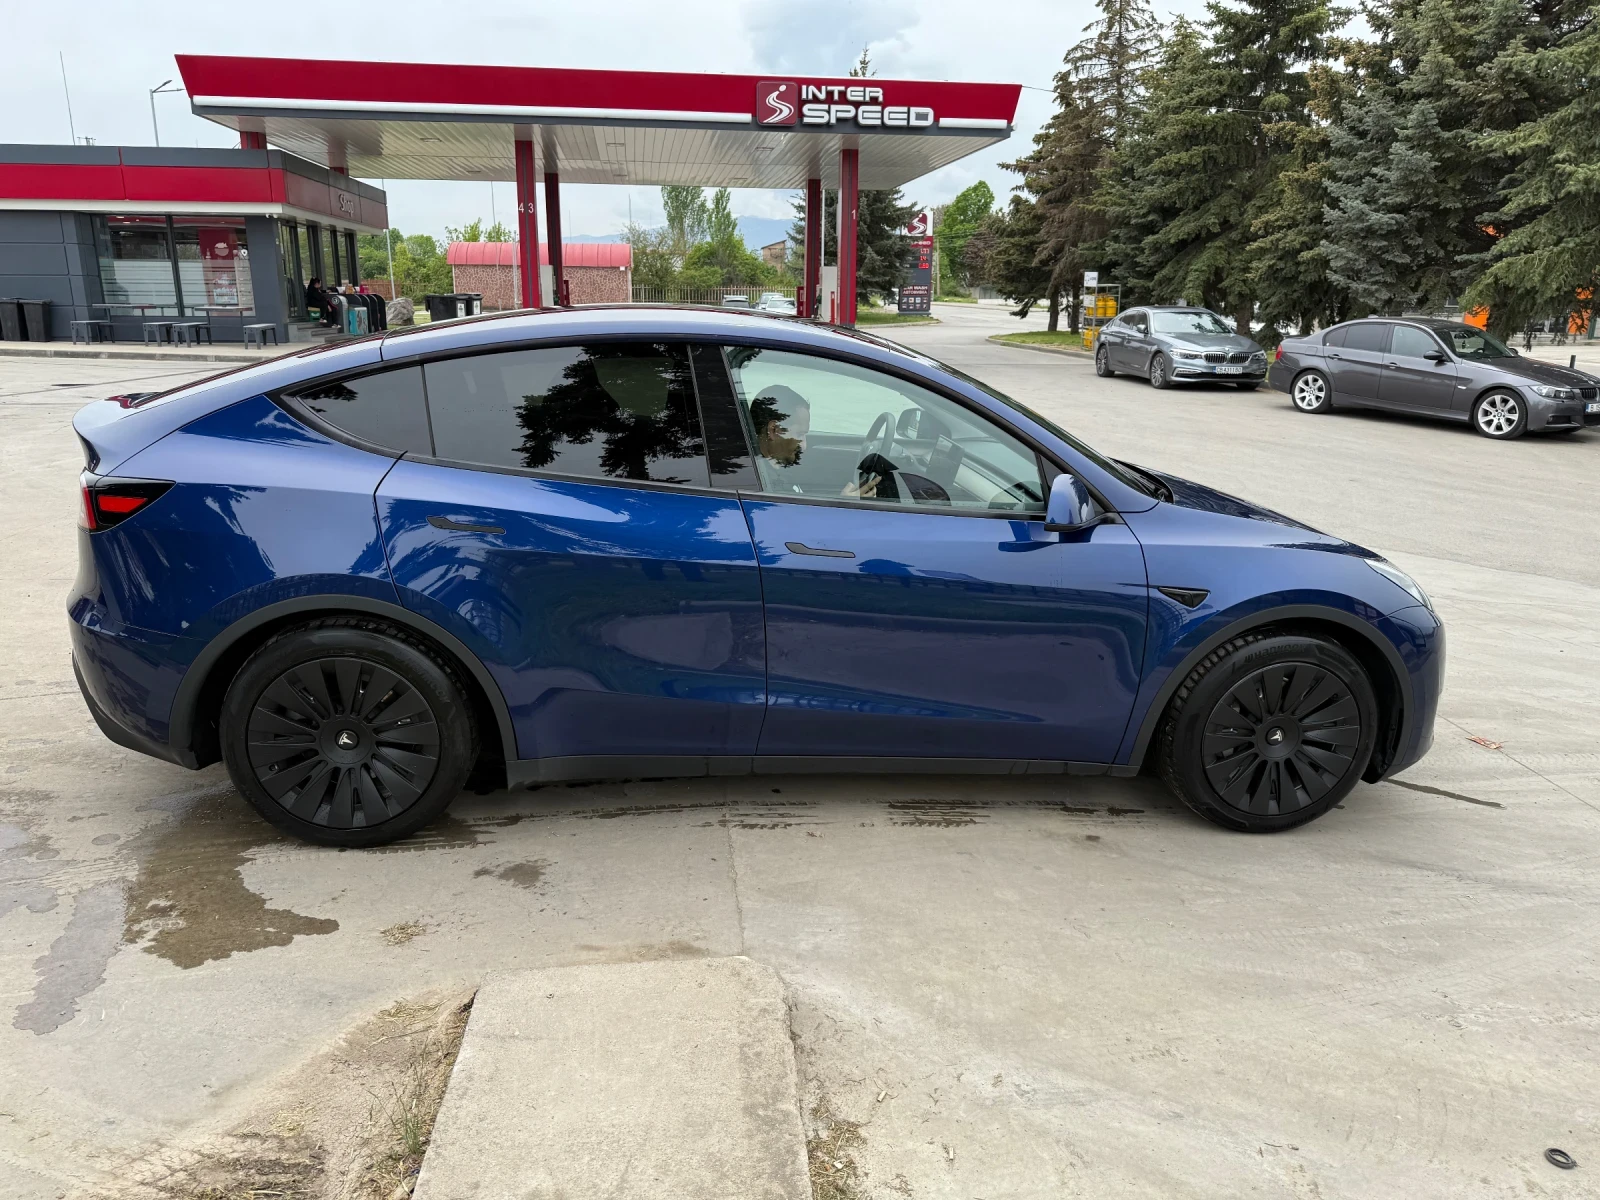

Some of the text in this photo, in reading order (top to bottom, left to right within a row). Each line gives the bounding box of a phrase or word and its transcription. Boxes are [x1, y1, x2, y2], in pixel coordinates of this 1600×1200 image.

[802, 85, 883, 102] INTER
[802, 104, 934, 126] SPEED
[339, 193, 354, 217] Shop
[518, 202, 534, 214] 4 3
[852, 209, 856, 220] 1
